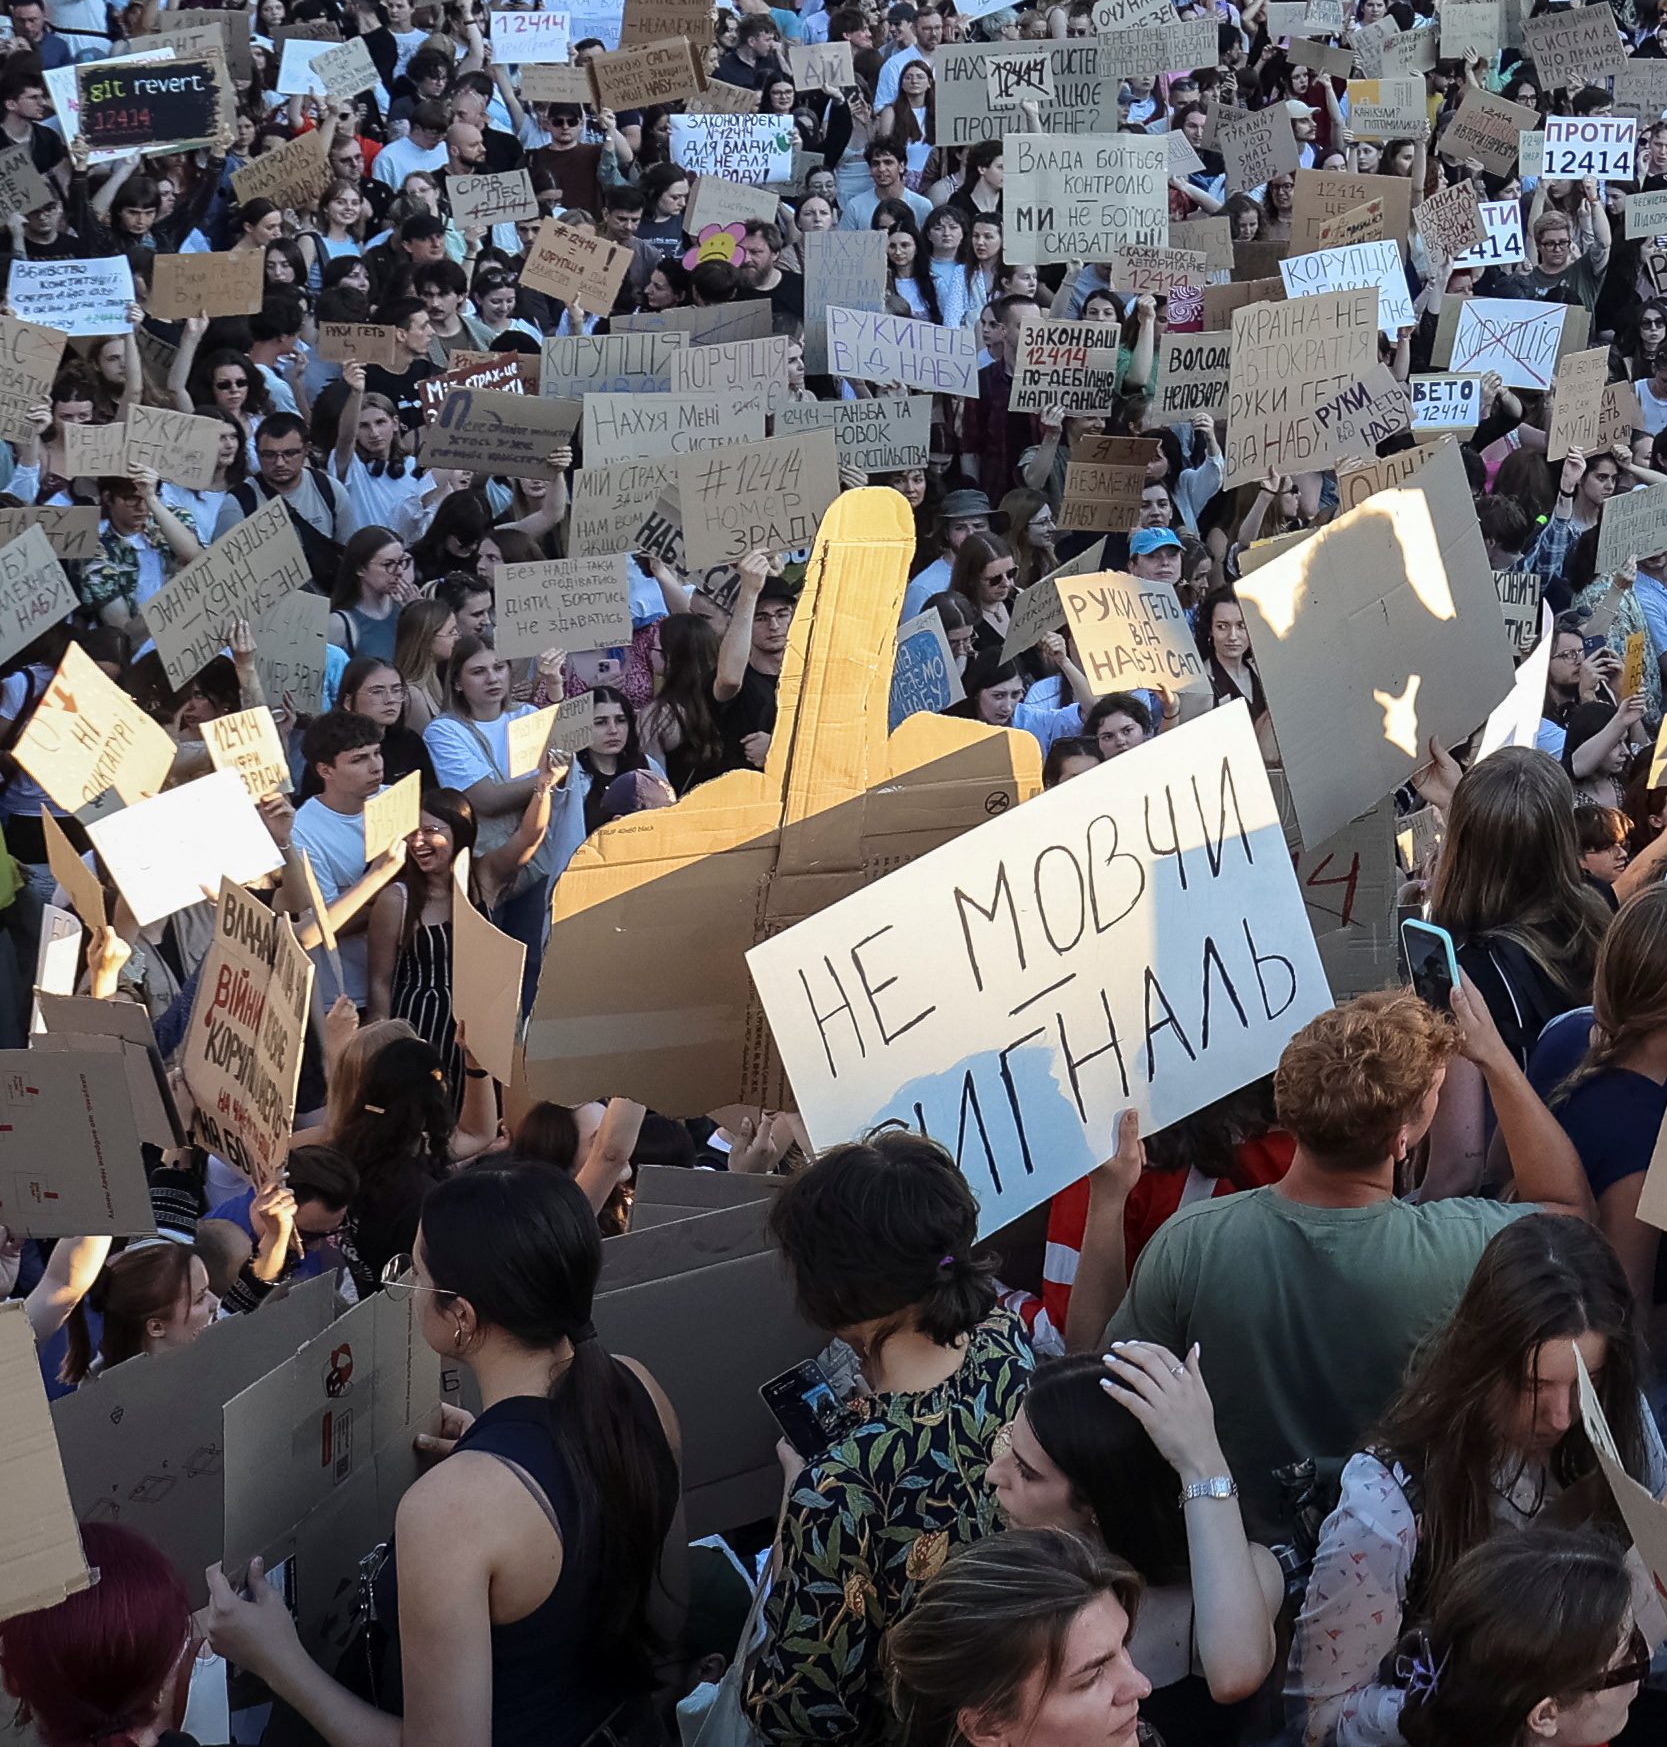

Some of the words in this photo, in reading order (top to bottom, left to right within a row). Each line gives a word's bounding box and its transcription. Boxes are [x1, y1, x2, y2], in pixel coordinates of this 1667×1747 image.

[89, 78, 124, 102] git
[133, 74, 205, 96] revert
[687, 113, 783, 128] ЗАКОНОПРОЄКТ
[1545, 120, 1636, 144] ПРОТИ
[1018, 148, 1082, 173] Влада
[1096, 146, 1165, 171] боїться
[1544, 149, 1632, 176] 12414
[1064, 172, 1154, 195] контролю
[1016, 206, 1054, 232] МИ
[1068, 204, 1091, 228] не
[830, 307, 905, 345] РУКИ
[906, 320, 976, 357] ГЕТЬ
[1024, 324, 1073, 346] ЗАКОН
[1075, 324, 1117, 348] ВАШ
[834, 341, 888, 375] ВІД
[900, 351, 972, 388] НАБУ
[1025, 347, 1086, 368] 12414
[1315, 380, 1373, 430] РУКИ
[1413, 380, 1473, 403] ВЕТО
[698, 450, 801, 500] #12414
[704, 490, 801, 531] НОМЕР
[1074, 591, 1132, 623] РУКИ
[1130, 620, 1157, 645] ВІД
[70, 718, 100, 750] НІ
[798, 924, 936, 1077] НЕ
[953, 756, 1254, 992] МОВЧИ
